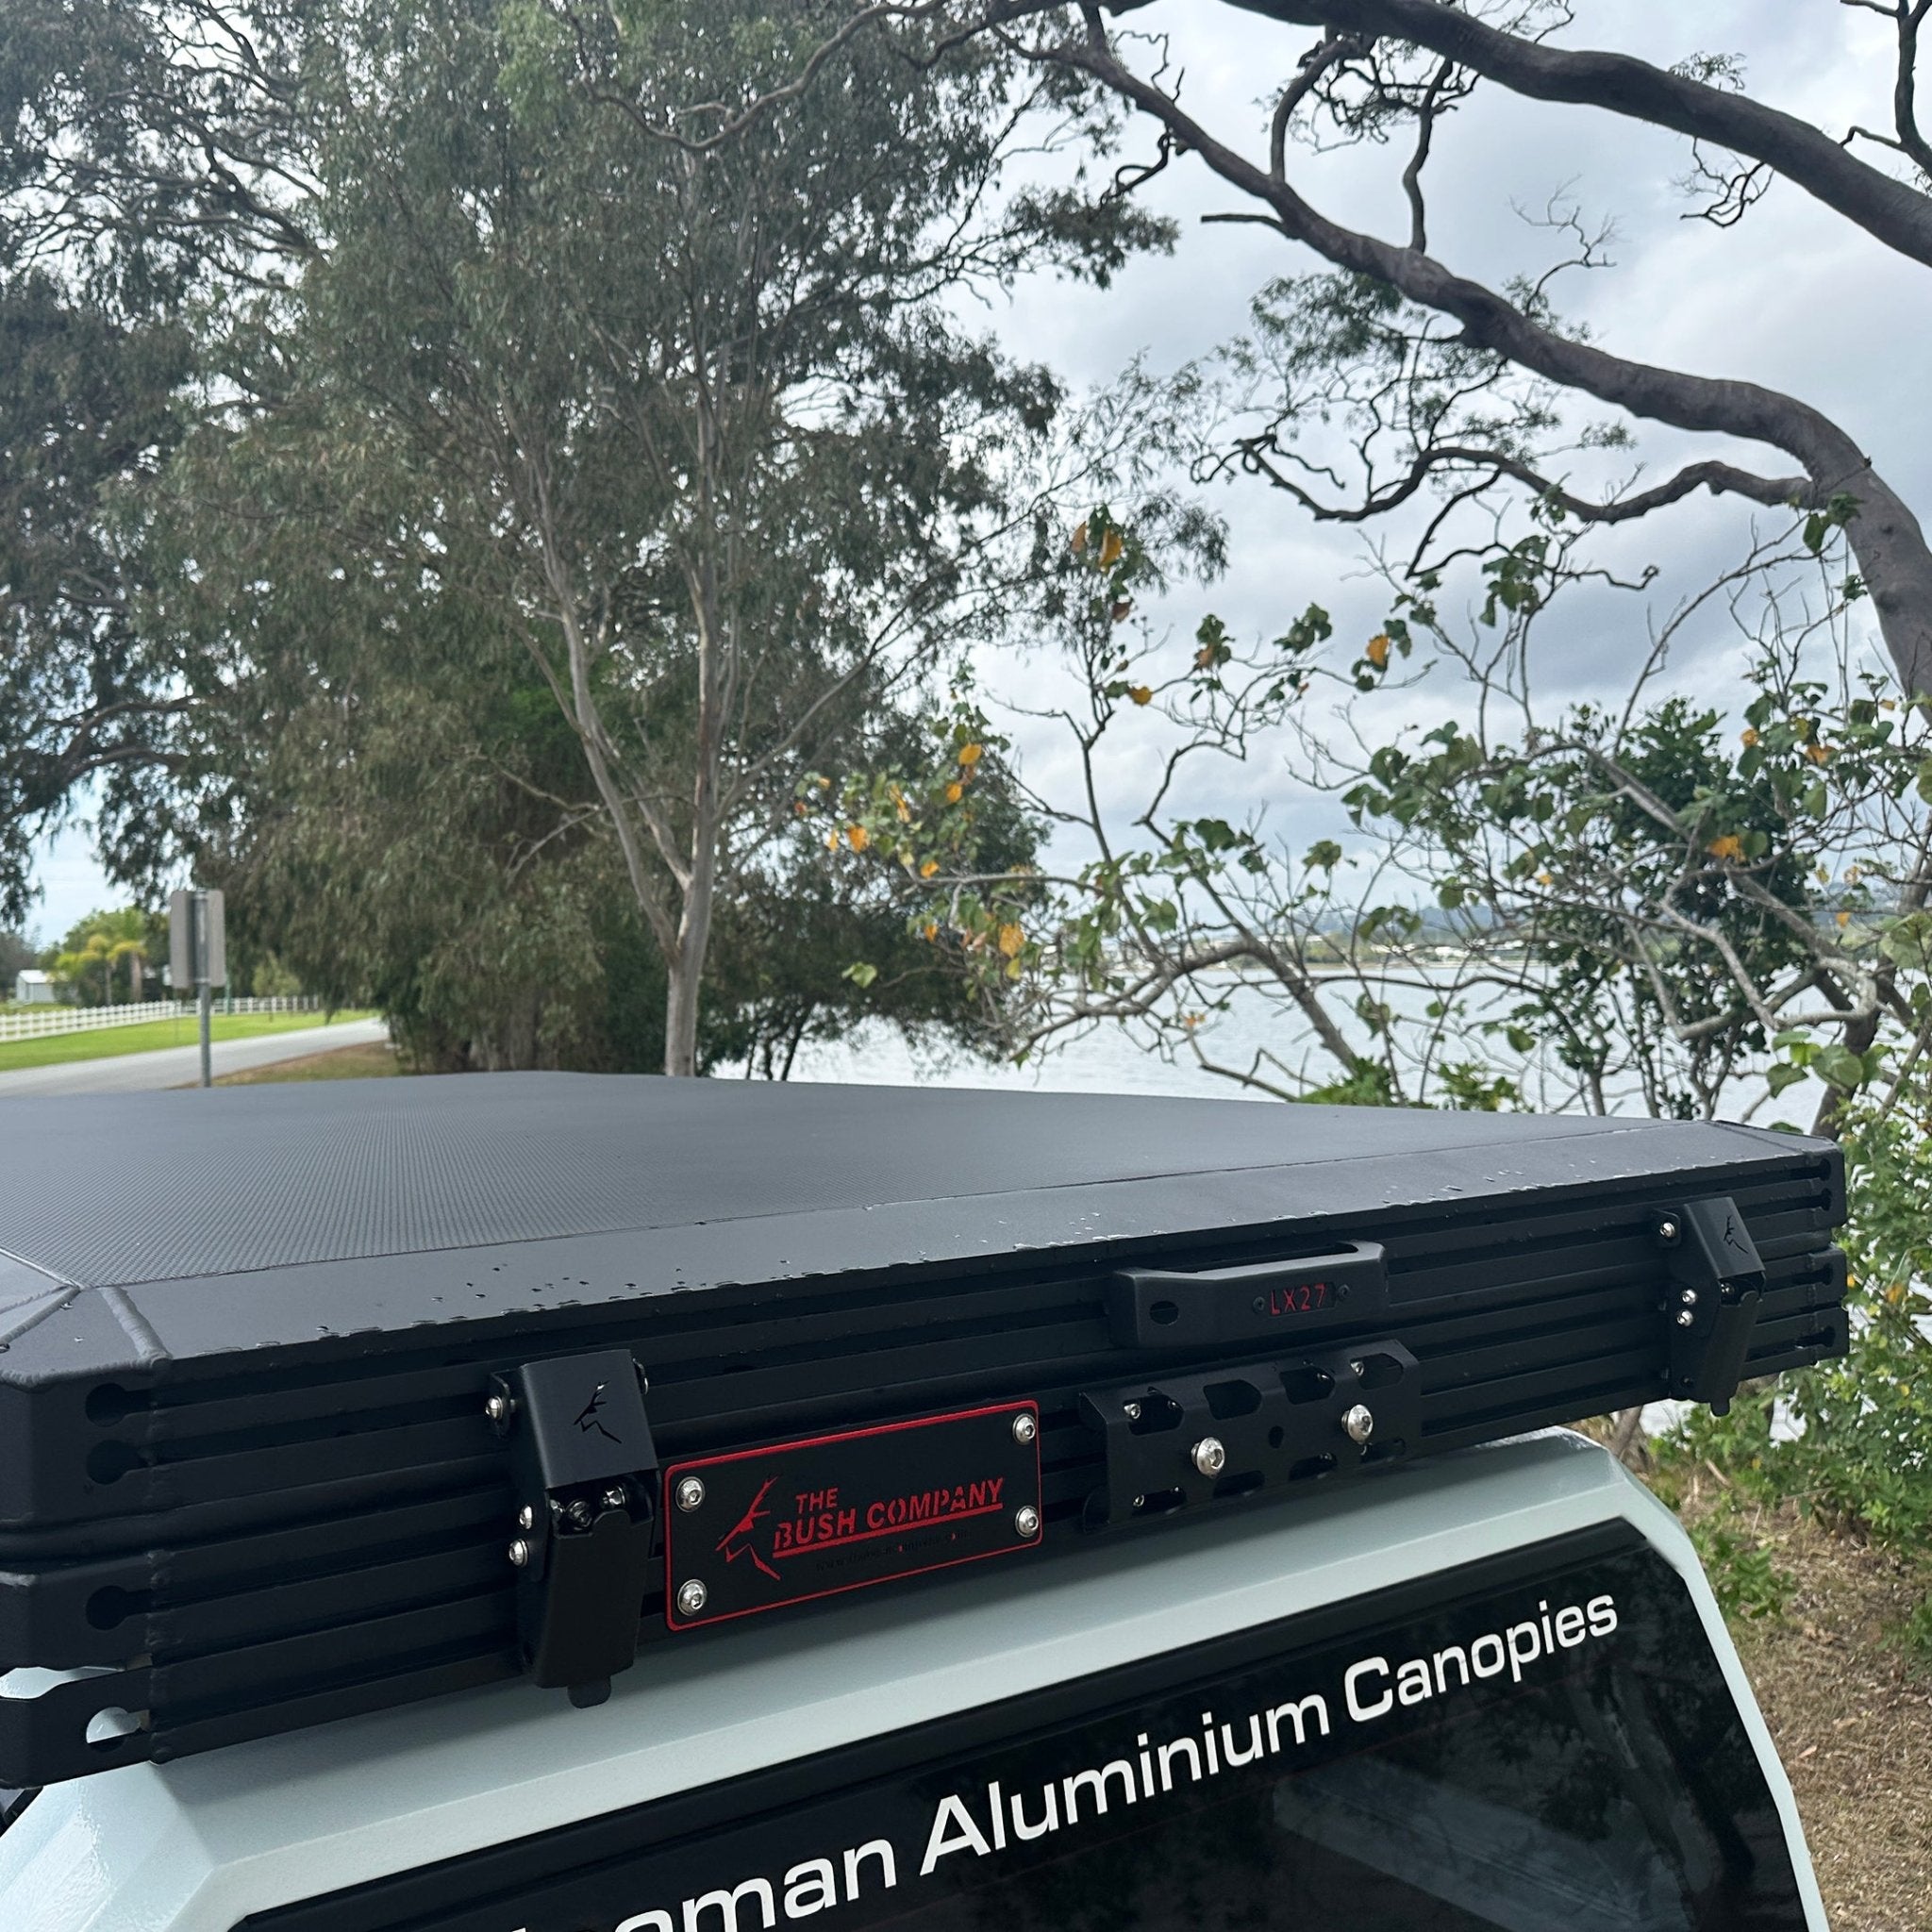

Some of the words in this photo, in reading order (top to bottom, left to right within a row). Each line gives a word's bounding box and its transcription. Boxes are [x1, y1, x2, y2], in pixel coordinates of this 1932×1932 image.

[1270, 1283, 1326, 1316] LX27
[774, 1508, 857, 1549] BUSH
[867, 1478, 1005, 1528] COMPANY
[795, 1487, 839, 1513] THE
[919, 1694, 1330, 1876] Aluminium
[1344, 1593, 1618, 1723] Canopies
